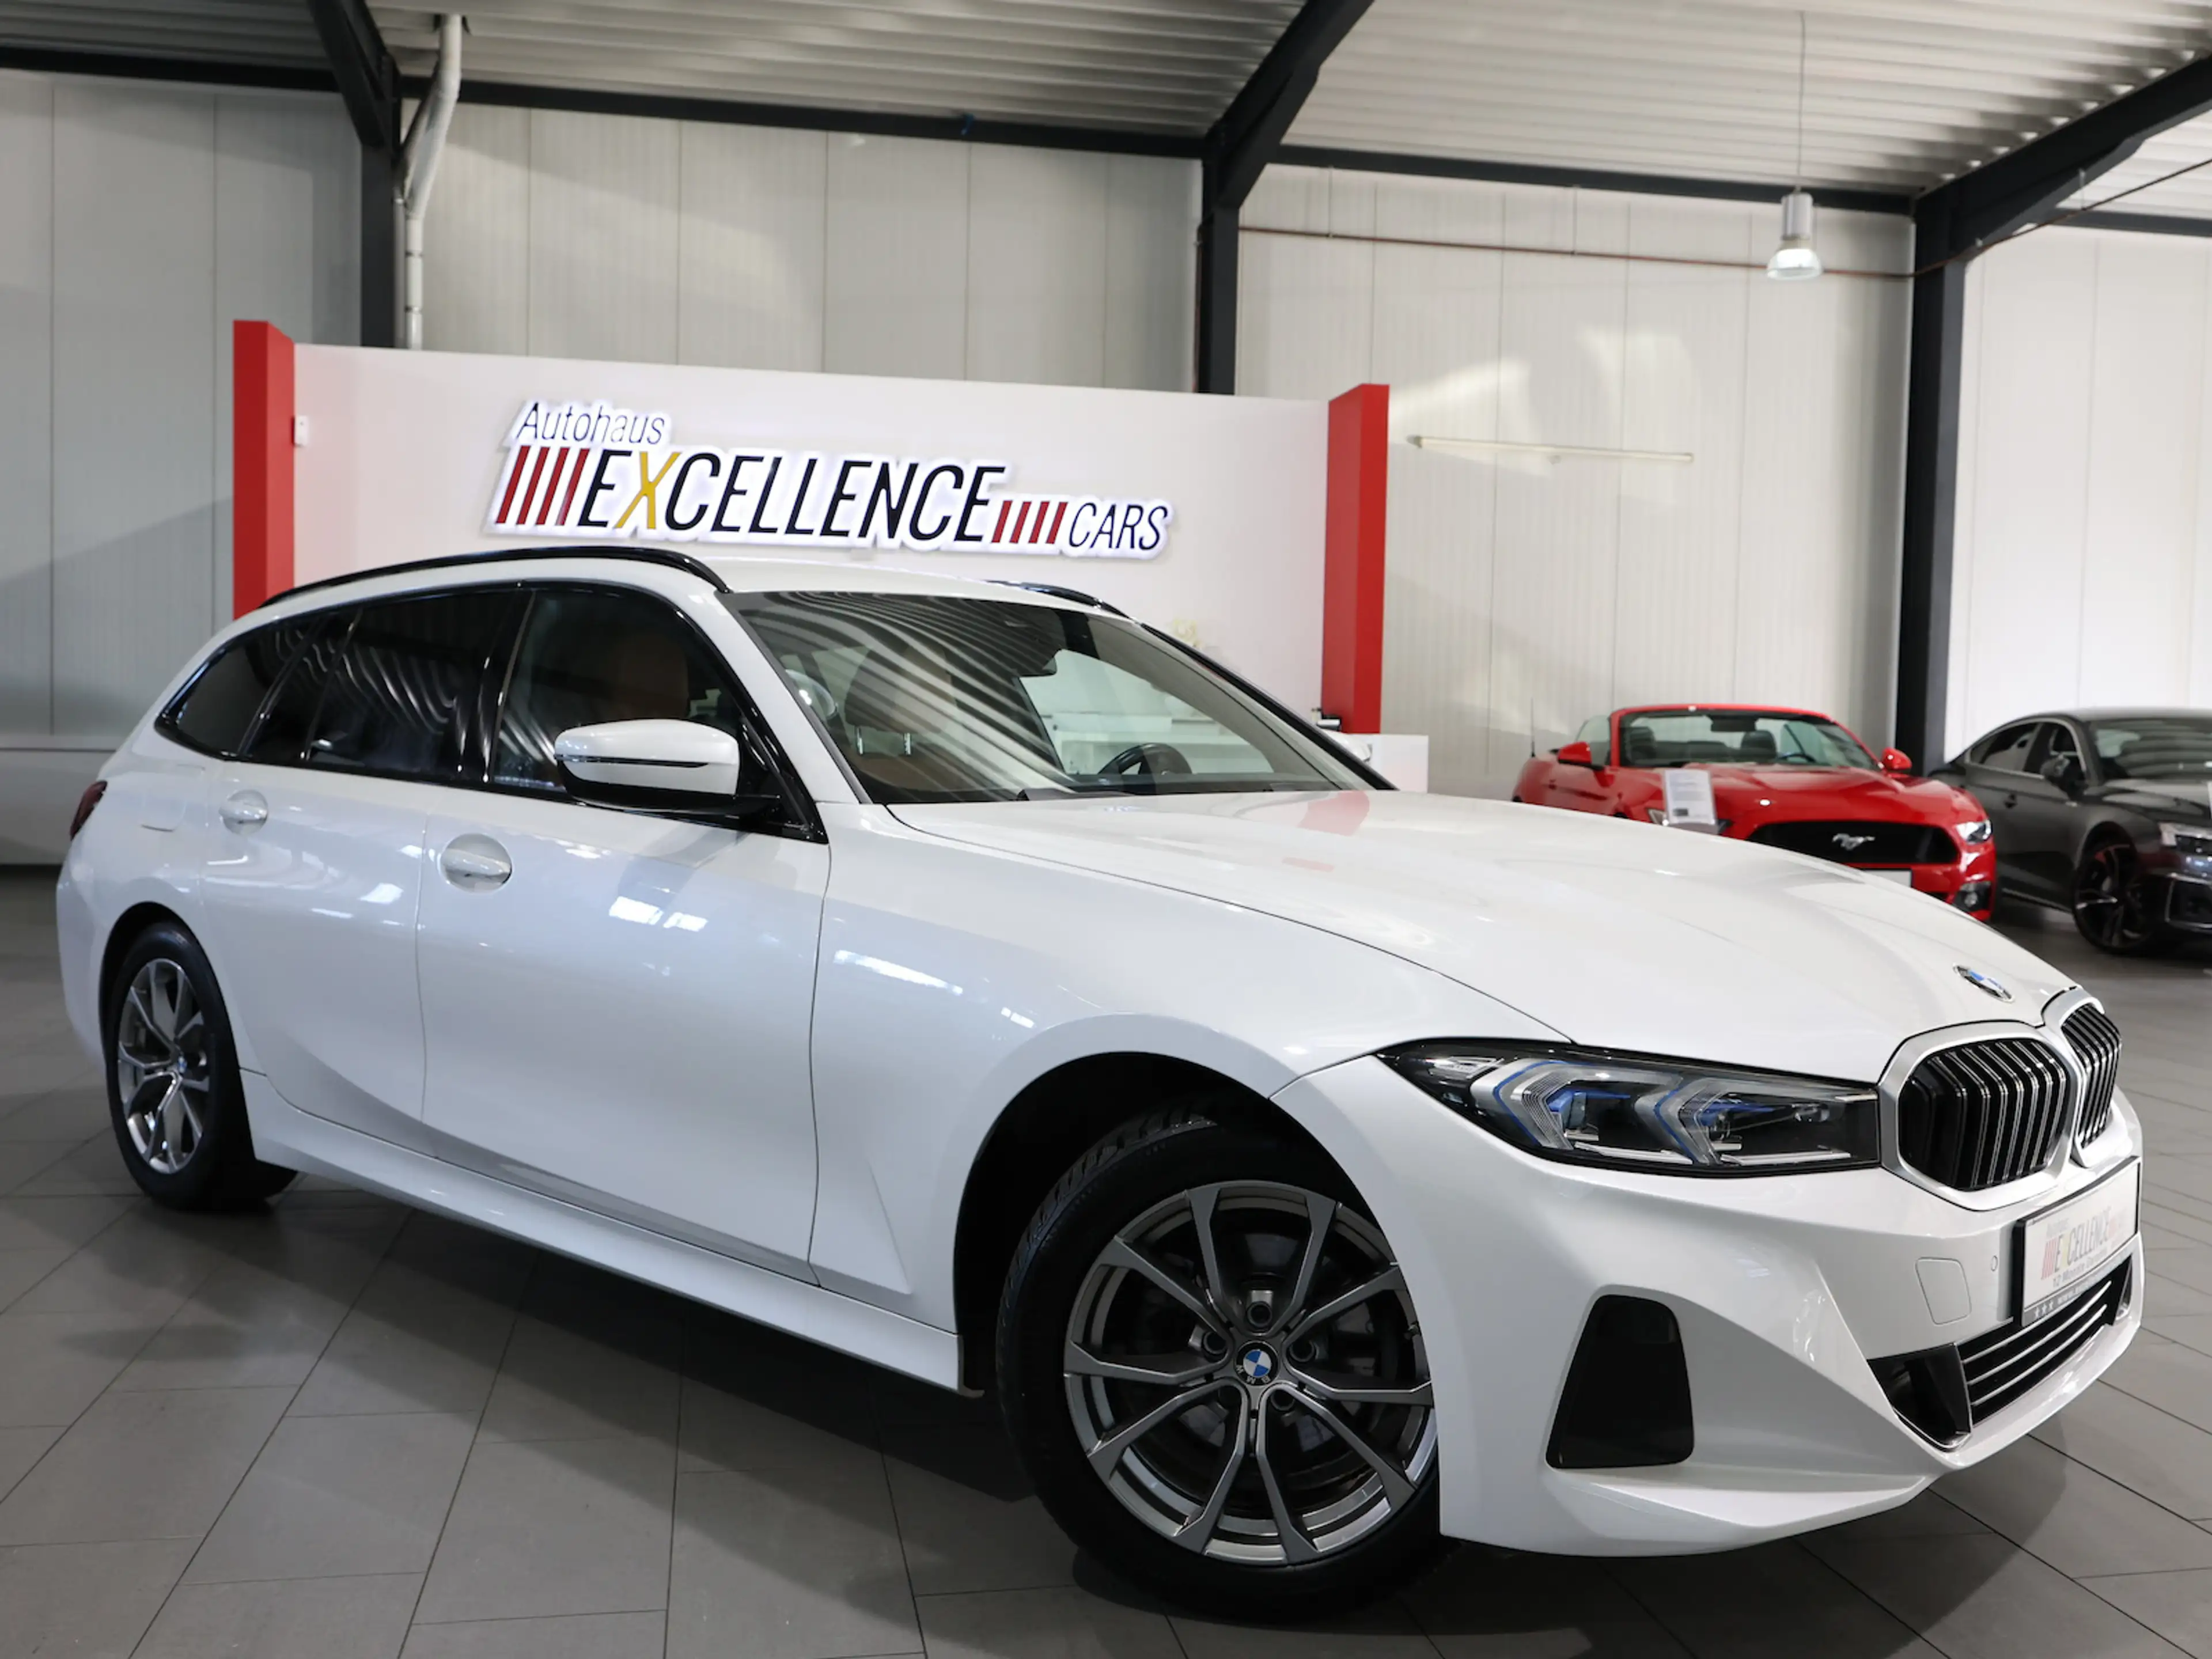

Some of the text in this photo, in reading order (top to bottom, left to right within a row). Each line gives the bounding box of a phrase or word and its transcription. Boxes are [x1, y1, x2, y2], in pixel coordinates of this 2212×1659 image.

[516, 402, 665, 445] Autohaus
[577, 449, 1168, 550] EXCELLENCE CARS
[1236, 1365, 1271, 1385] BMW
